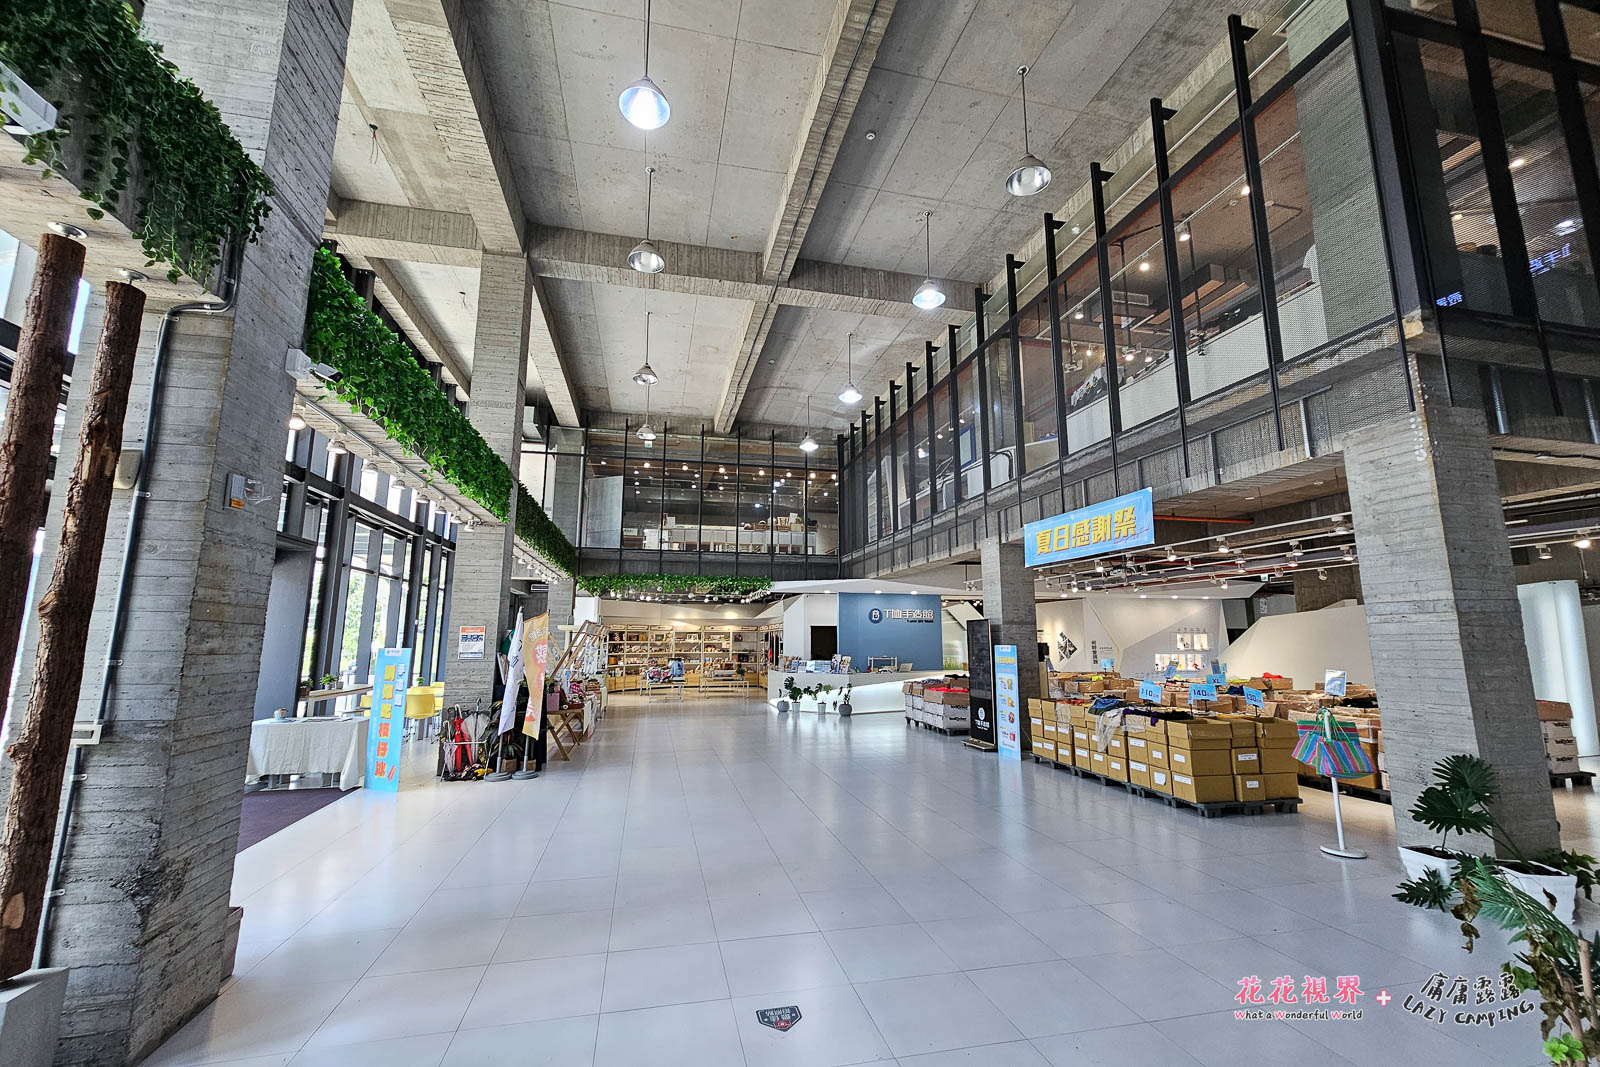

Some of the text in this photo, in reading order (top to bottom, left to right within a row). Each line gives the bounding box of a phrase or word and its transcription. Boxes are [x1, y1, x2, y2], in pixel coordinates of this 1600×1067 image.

[1036, 505, 1137, 556] 夏日感謝祭
[883, 609, 934, 619] T恤手造館
